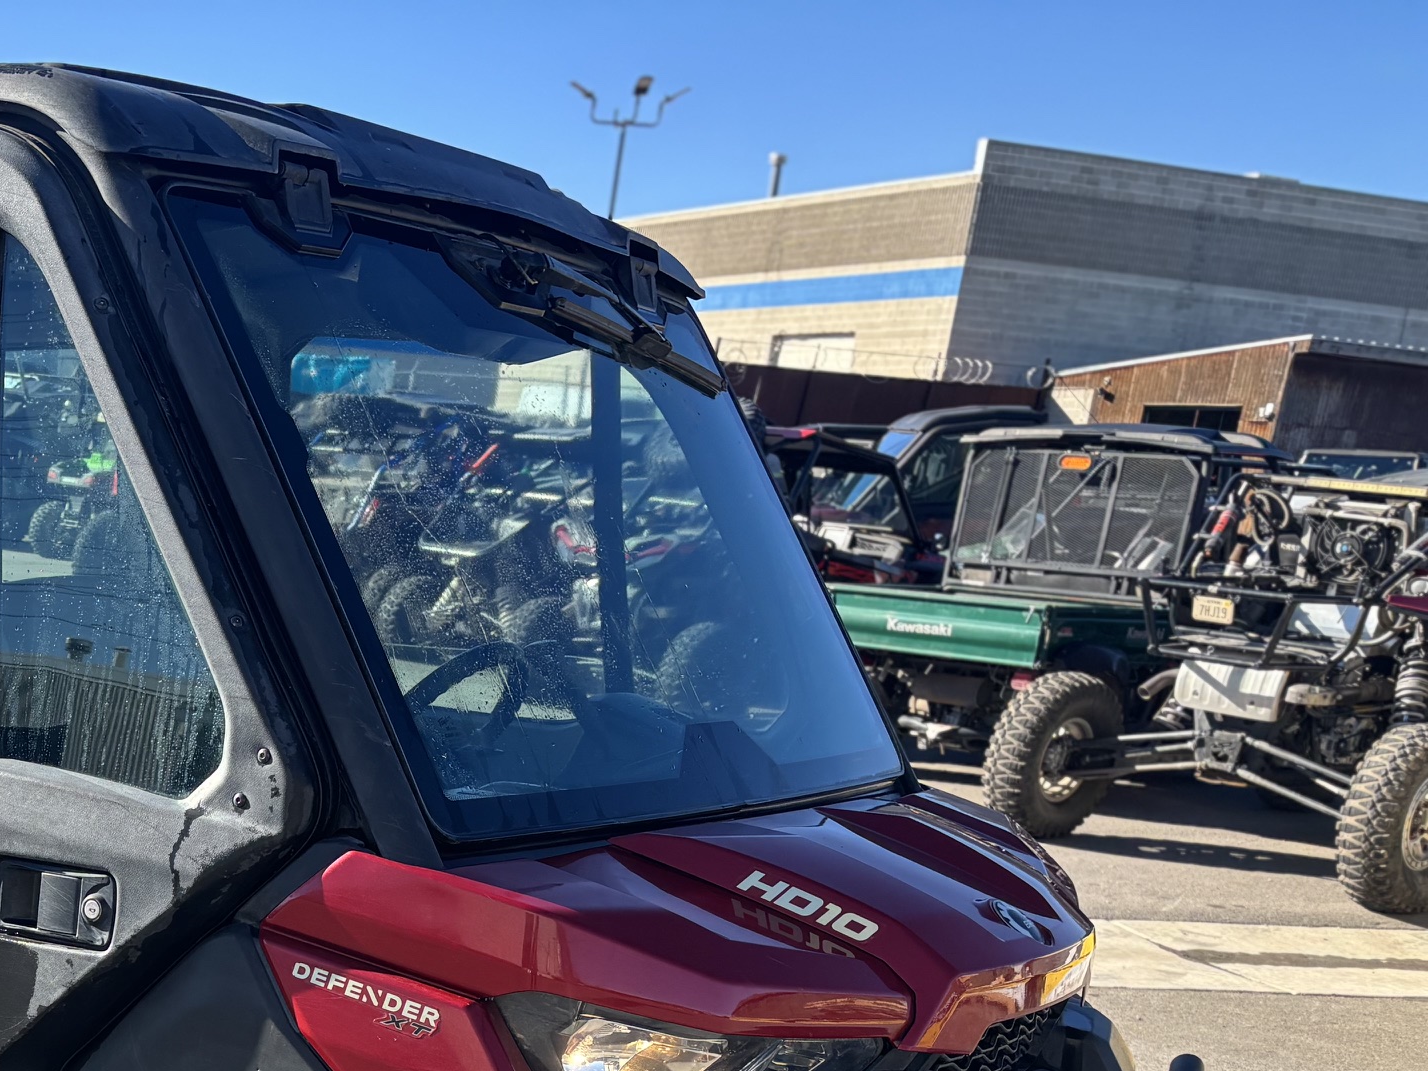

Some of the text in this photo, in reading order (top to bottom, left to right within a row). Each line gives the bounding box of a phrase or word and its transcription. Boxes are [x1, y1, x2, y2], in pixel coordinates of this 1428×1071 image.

[886, 616, 952, 637] Kawasaki
[736, 870, 879, 941] HD10
[292, 962, 440, 1027] DEFENDER
[382, 1014, 435, 1037] XT
